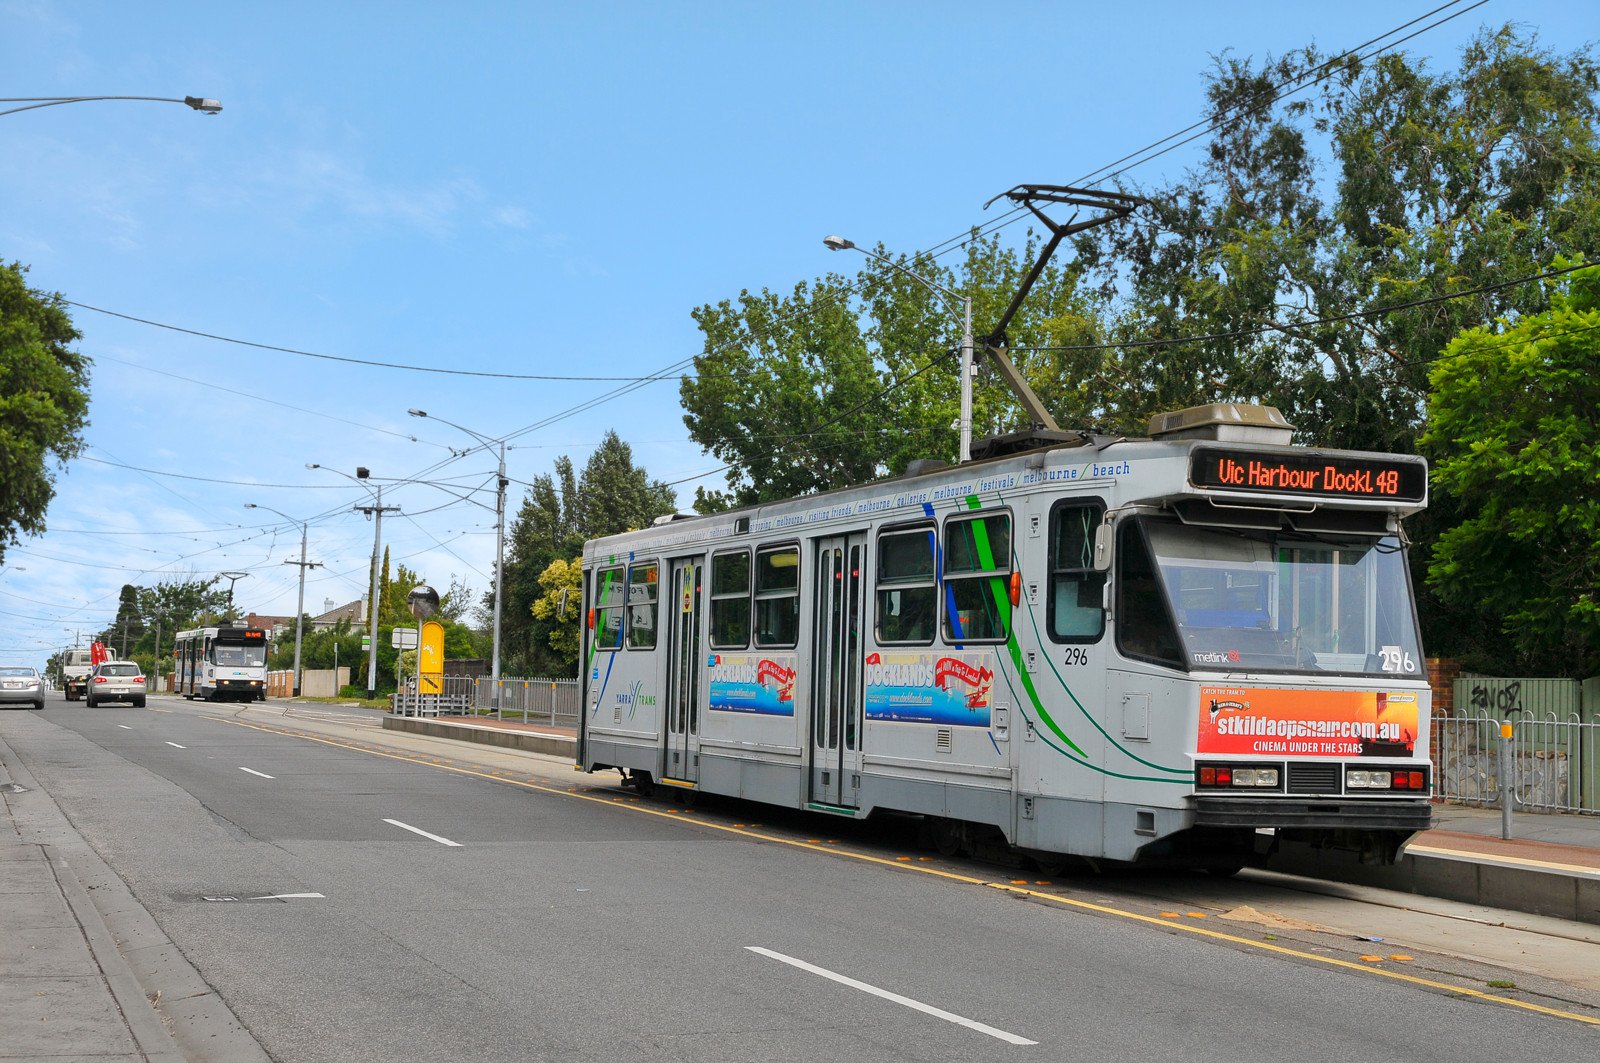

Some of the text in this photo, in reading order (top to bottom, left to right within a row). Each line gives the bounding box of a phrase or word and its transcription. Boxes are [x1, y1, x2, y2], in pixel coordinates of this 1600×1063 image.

[1219, 459, 1244, 484] Vic
[1248, 461, 1320, 489] Harbour
[1376, 470, 1399, 494] 48
[776, 514, 803, 527] melbourne
[808, 510, 830, 522] visiting
[831, 504, 852, 517] friends
[858, 498, 890, 513] melbourne
[896, 493, 927, 507] galleries
[934, 485, 972, 500] melbourne
[980, 474, 1014, 491] festivals
[1023, 468, 1077, 484] melbourne
[1093, 461, 1130, 477] beach
[1065, 647, 1088, 666] 296
[1194, 651, 1230, 663] metlink
[1378, 650, 1415, 673] 296
[710, 664, 757, 684] DOCKLANDS
[867, 664, 935, 688] DOCKLANDS
[616, 694, 656, 706] YARRA TRAMS
[1217, 715, 1400, 740] stkildaopenair.com.au
[1253, 741, 1363, 754] CINEMA UNDER THE STARS
